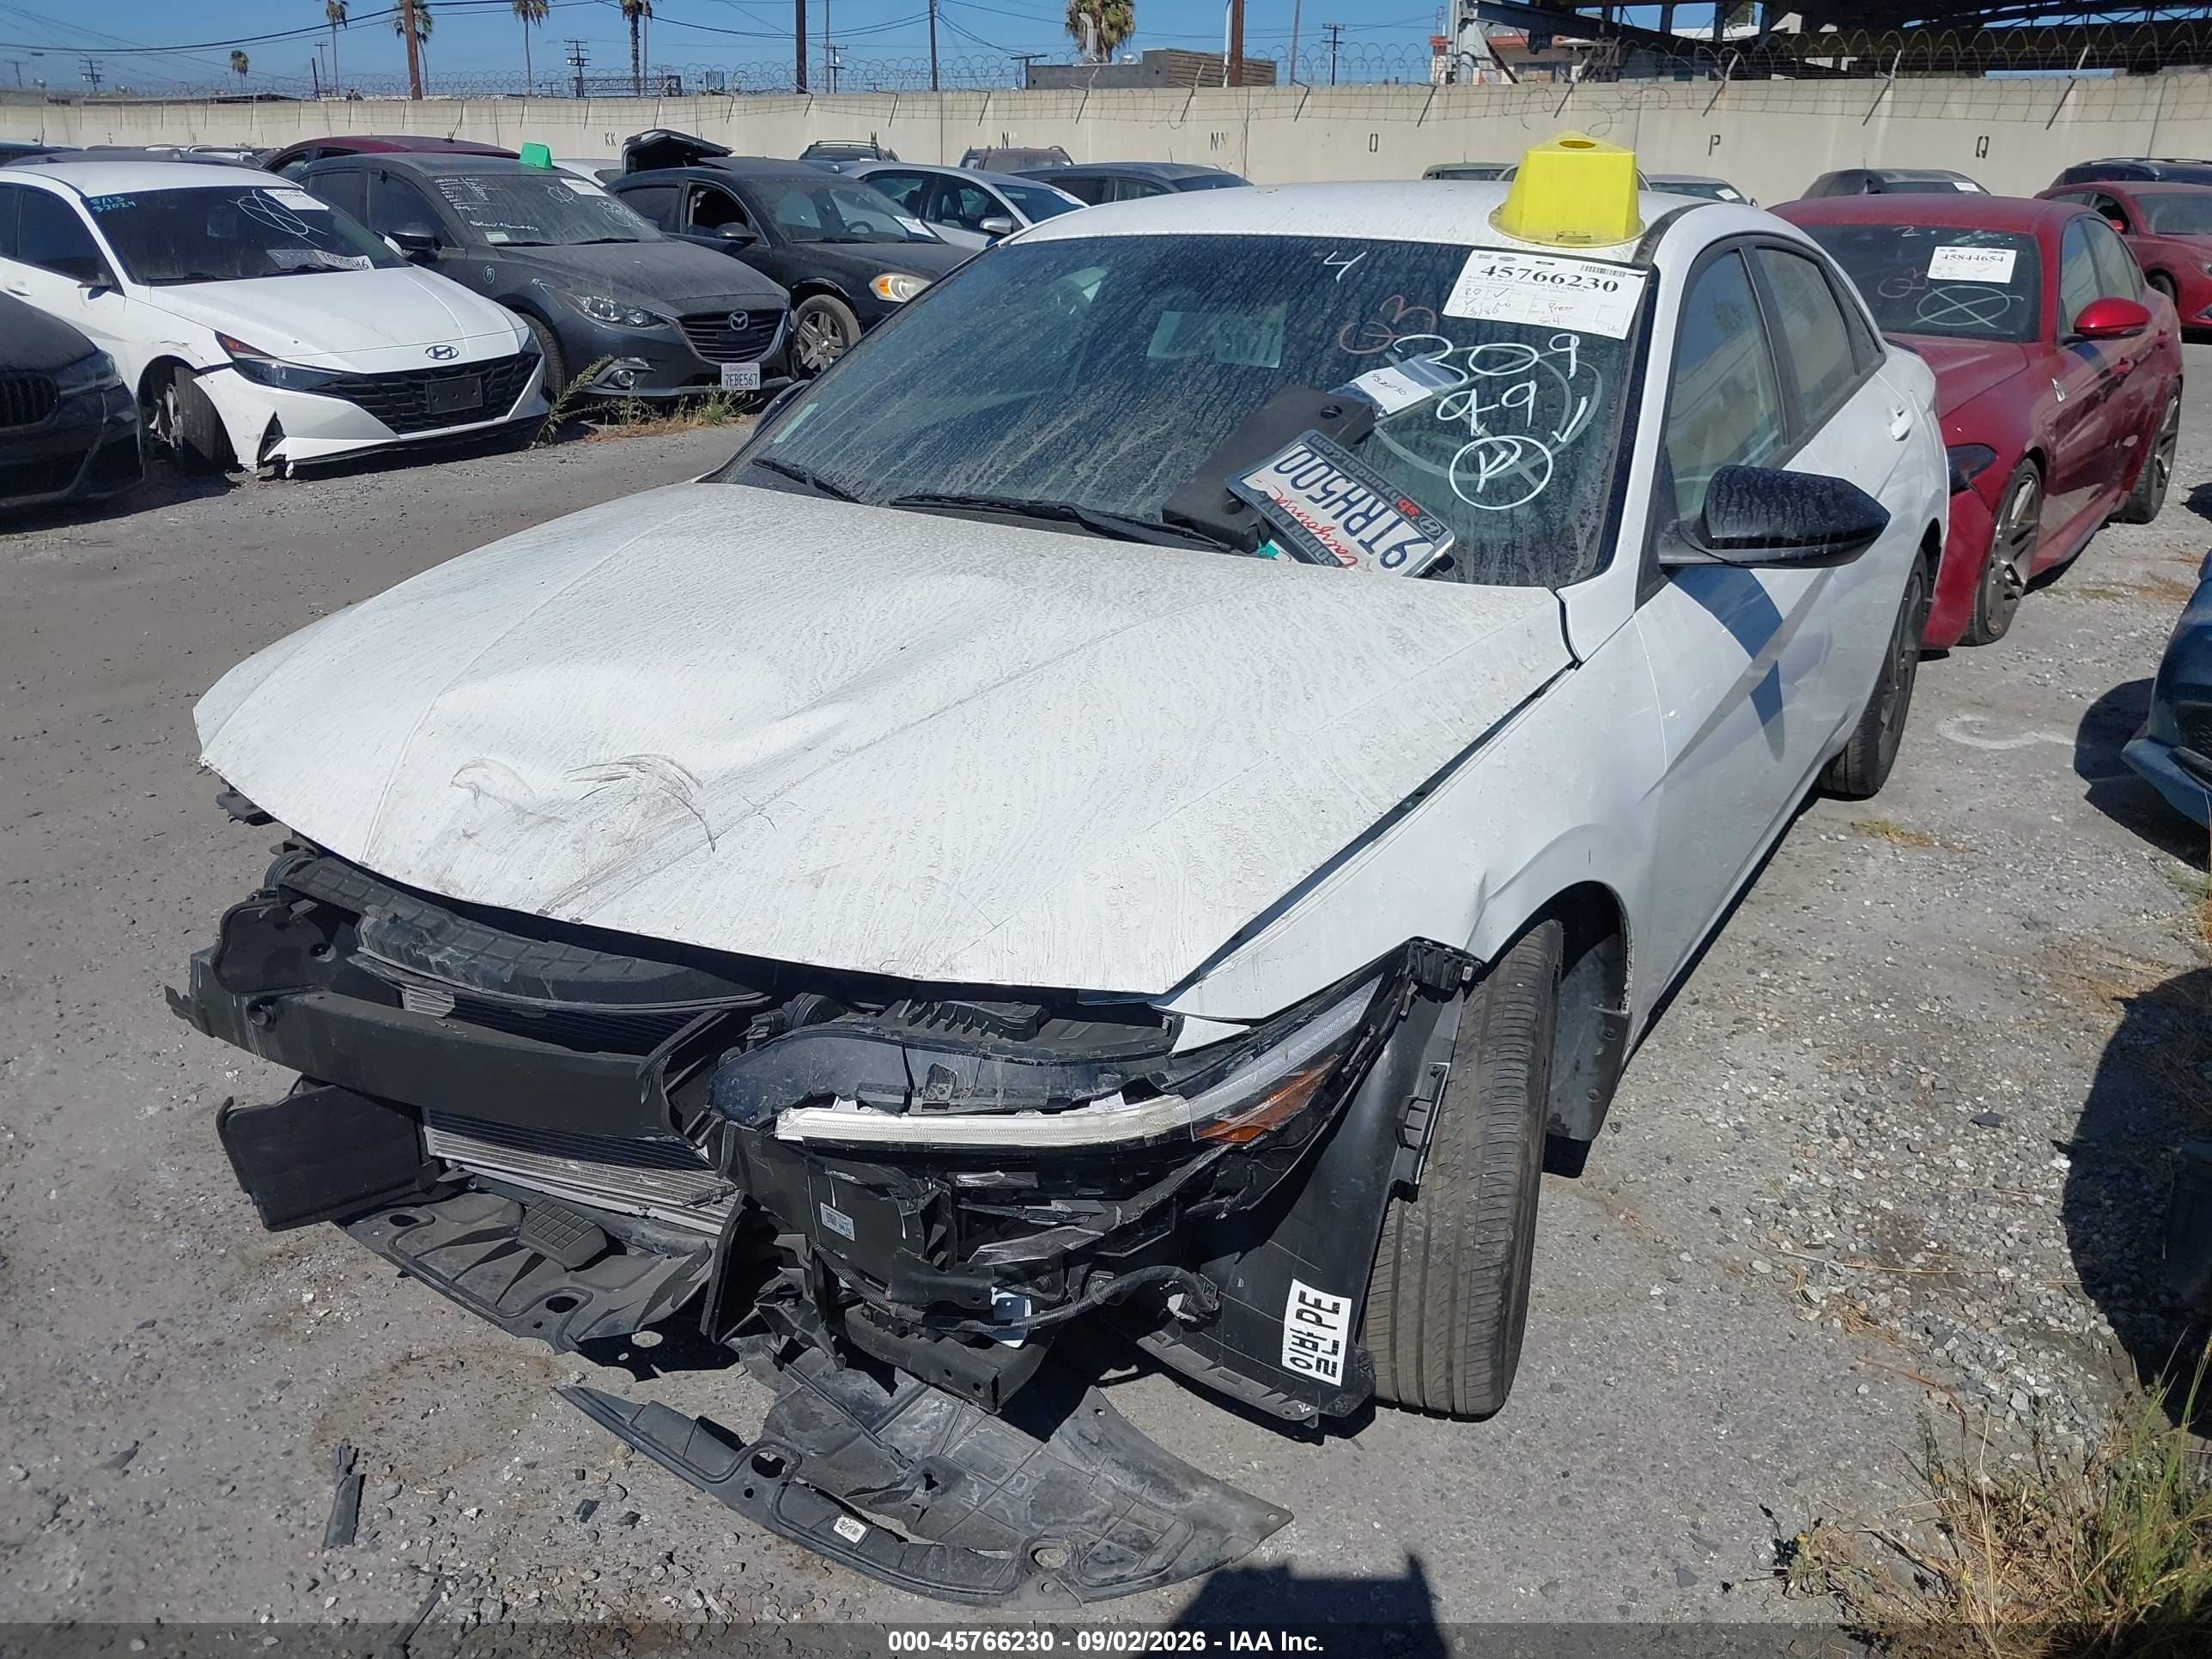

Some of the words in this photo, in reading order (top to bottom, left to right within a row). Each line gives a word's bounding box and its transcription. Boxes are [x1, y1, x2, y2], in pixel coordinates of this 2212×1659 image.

[604, 131, 617, 147] KK
[1708, 134, 1721, 156] P
[1975, 136, 1990, 159] Q
[1322, 250, 1367, 283] 4
[1480, 264, 1620, 293] 45766230
[724, 373, 757, 386] 7FBE567
[1273, 449, 1431, 569] 9TRH500
[1273, 484, 1358, 568] California
[1295, 1290, 1340, 1331] PE
[1289, 1328, 1340, 1378] 일반
